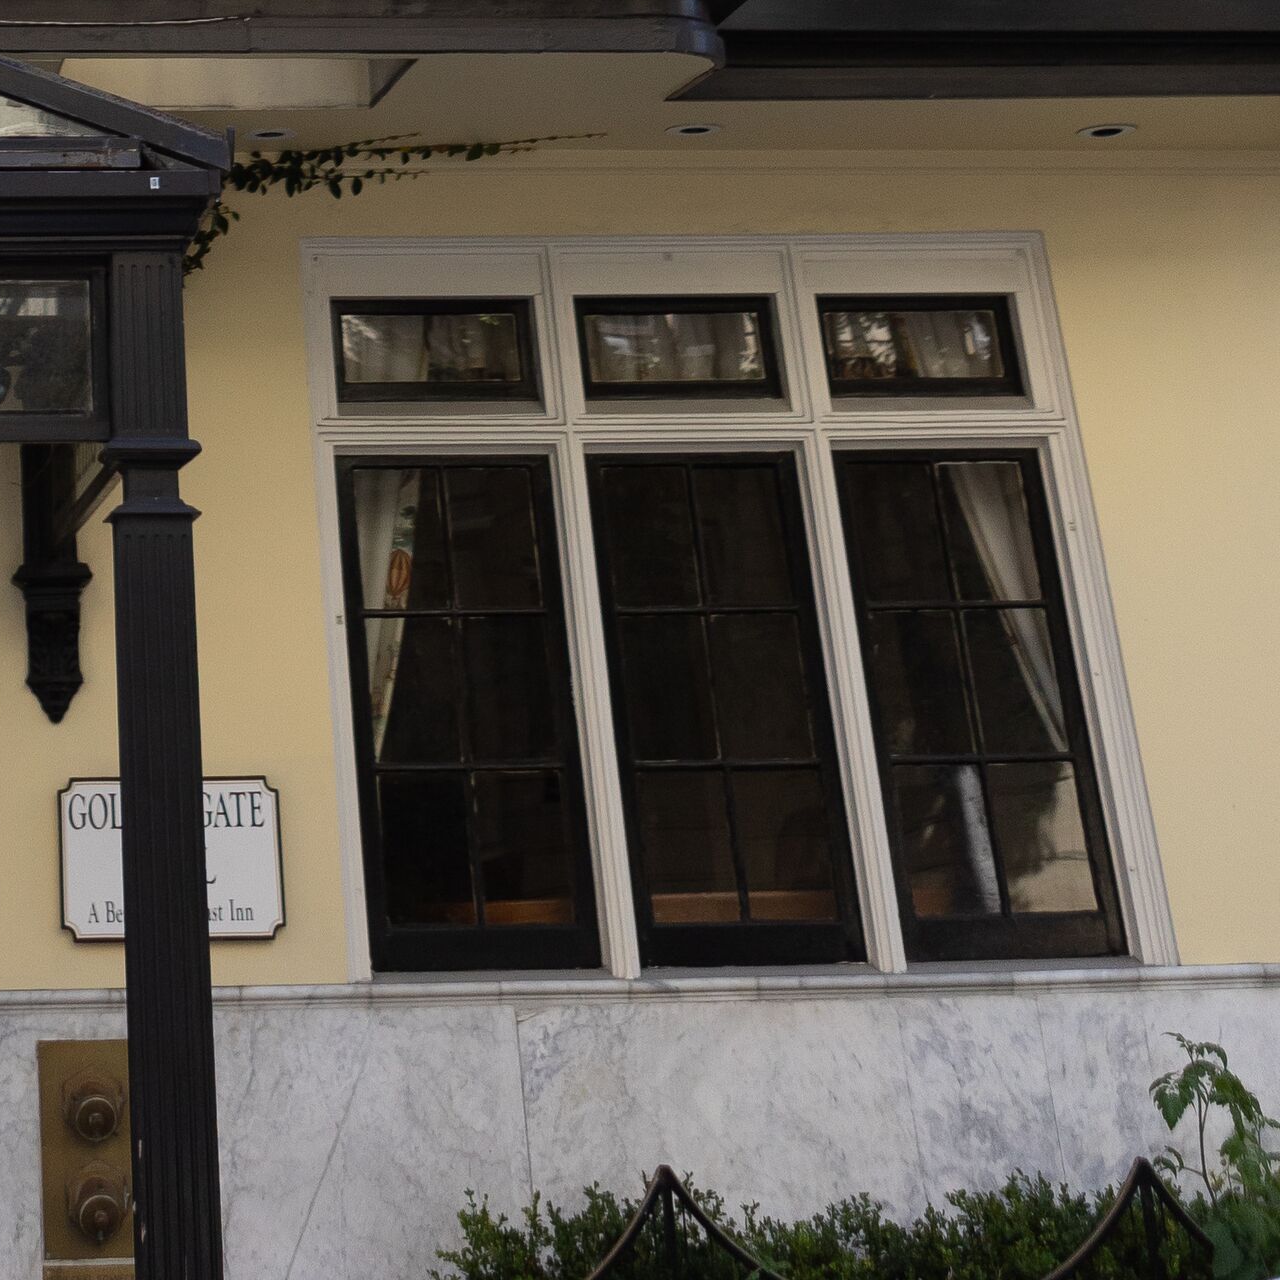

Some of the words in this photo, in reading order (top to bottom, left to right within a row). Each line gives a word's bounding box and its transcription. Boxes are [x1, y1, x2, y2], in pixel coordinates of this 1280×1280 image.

[68, 792, 123, 830] GOL
[202, 791, 265, 828] GATE
[88, 903, 100, 923] A
[105, 901, 123, 923] Be
[229, 899, 255, 922] Inn
